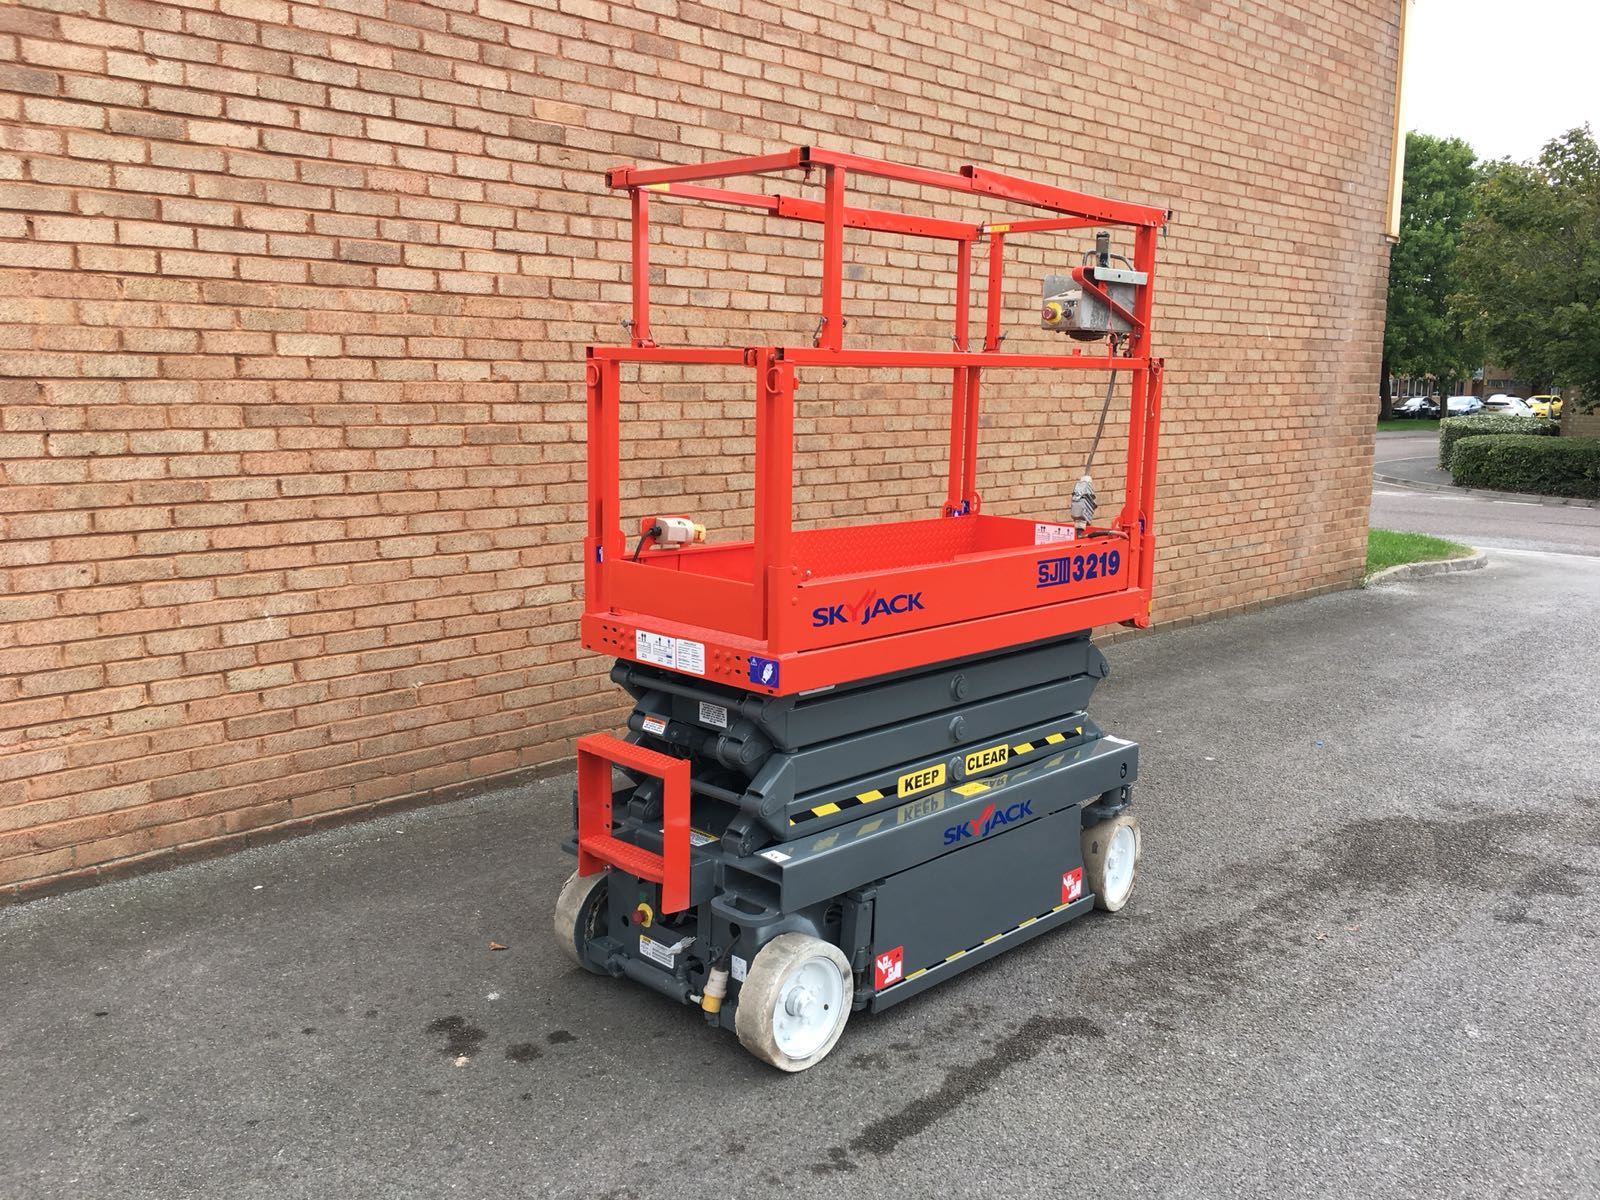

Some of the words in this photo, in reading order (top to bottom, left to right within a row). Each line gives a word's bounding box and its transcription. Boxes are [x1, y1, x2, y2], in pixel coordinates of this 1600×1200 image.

[1072, 549, 1121, 582] 3219
[812, 588, 926, 628] SKYJACK
[904, 769, 940, 793] KEEP
[966, 748, 1007, 771] CLEAR
[943, 800, 1034, 846] SKYJACK
